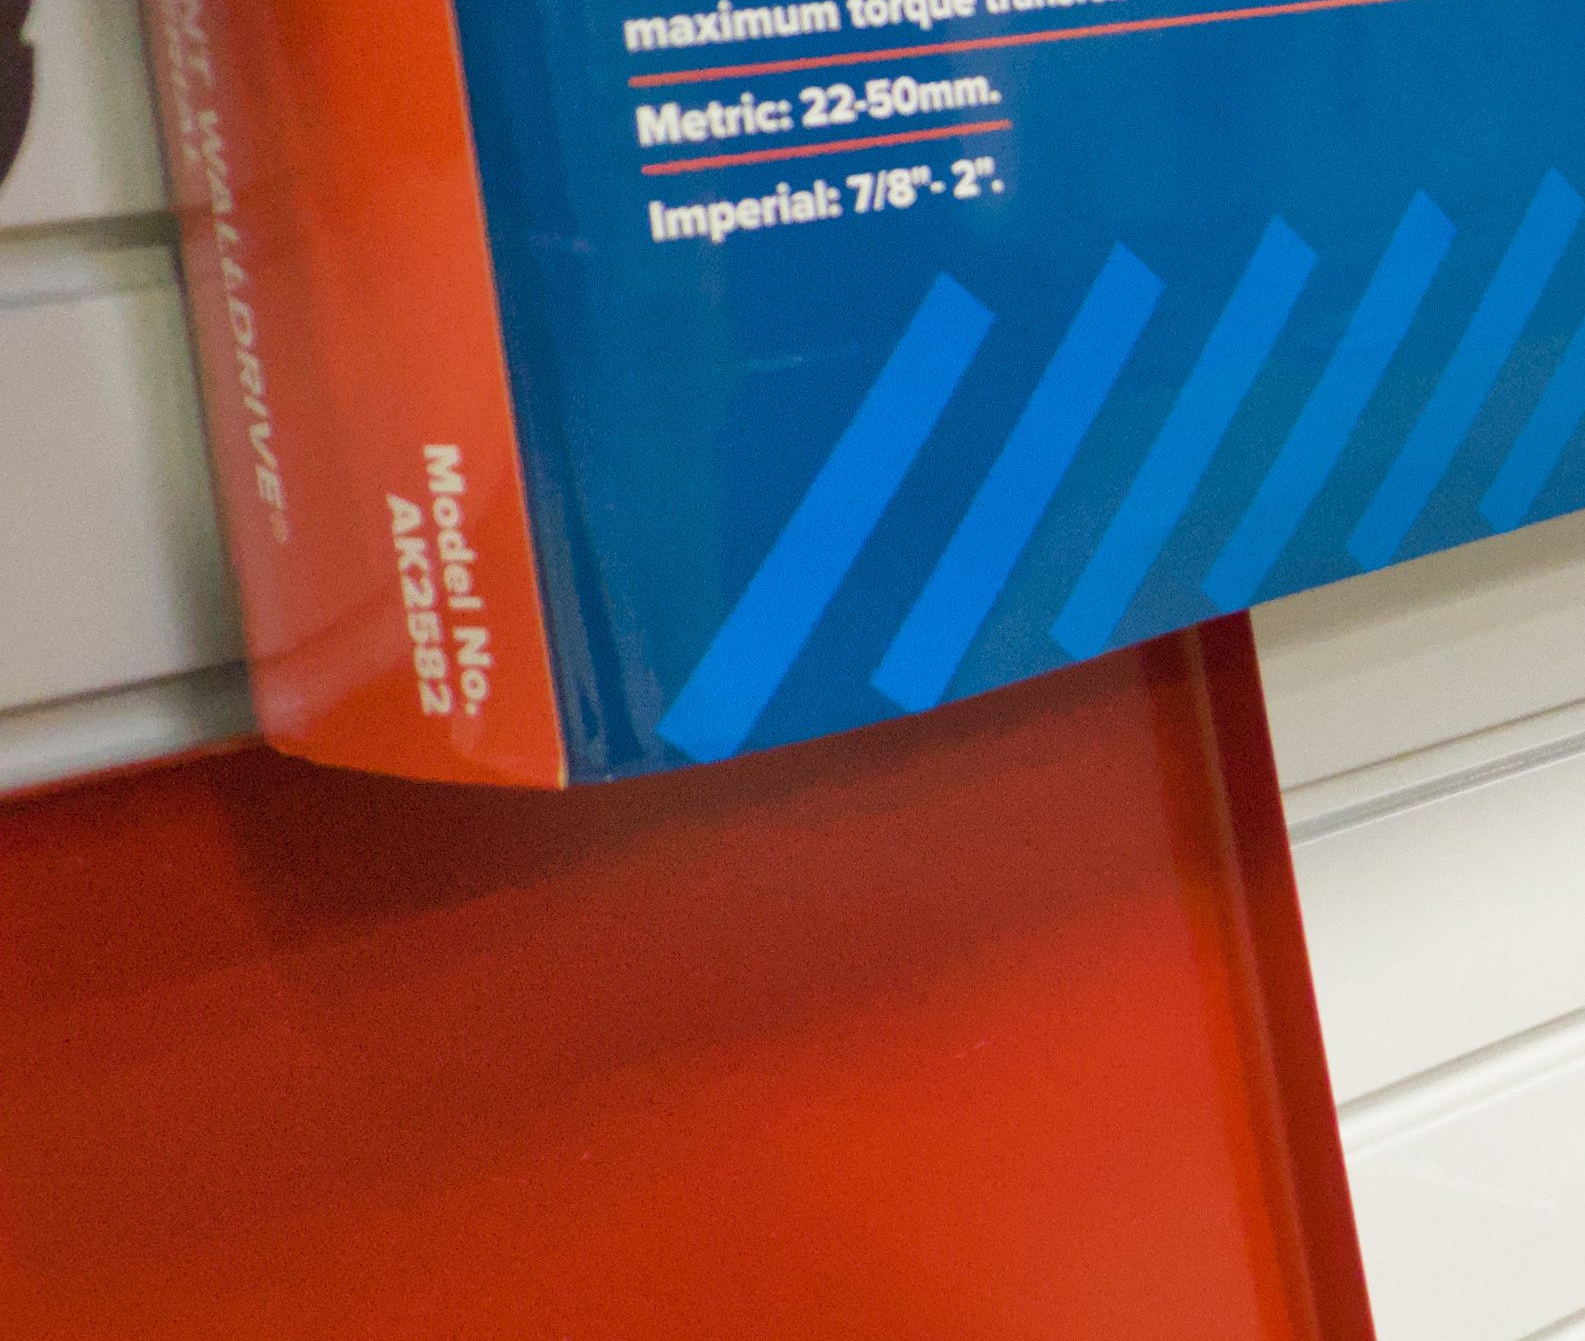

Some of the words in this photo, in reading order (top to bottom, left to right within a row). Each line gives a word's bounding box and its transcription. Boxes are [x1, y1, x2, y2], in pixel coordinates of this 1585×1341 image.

[636, 95, 792, 145] Metric:
[800, 76, 1001, 128] 22-50mm.
[424, 444, 485, 610] Model
[385, 492, 452, 716] AK2582
[452, 628, 492, 717] No.
